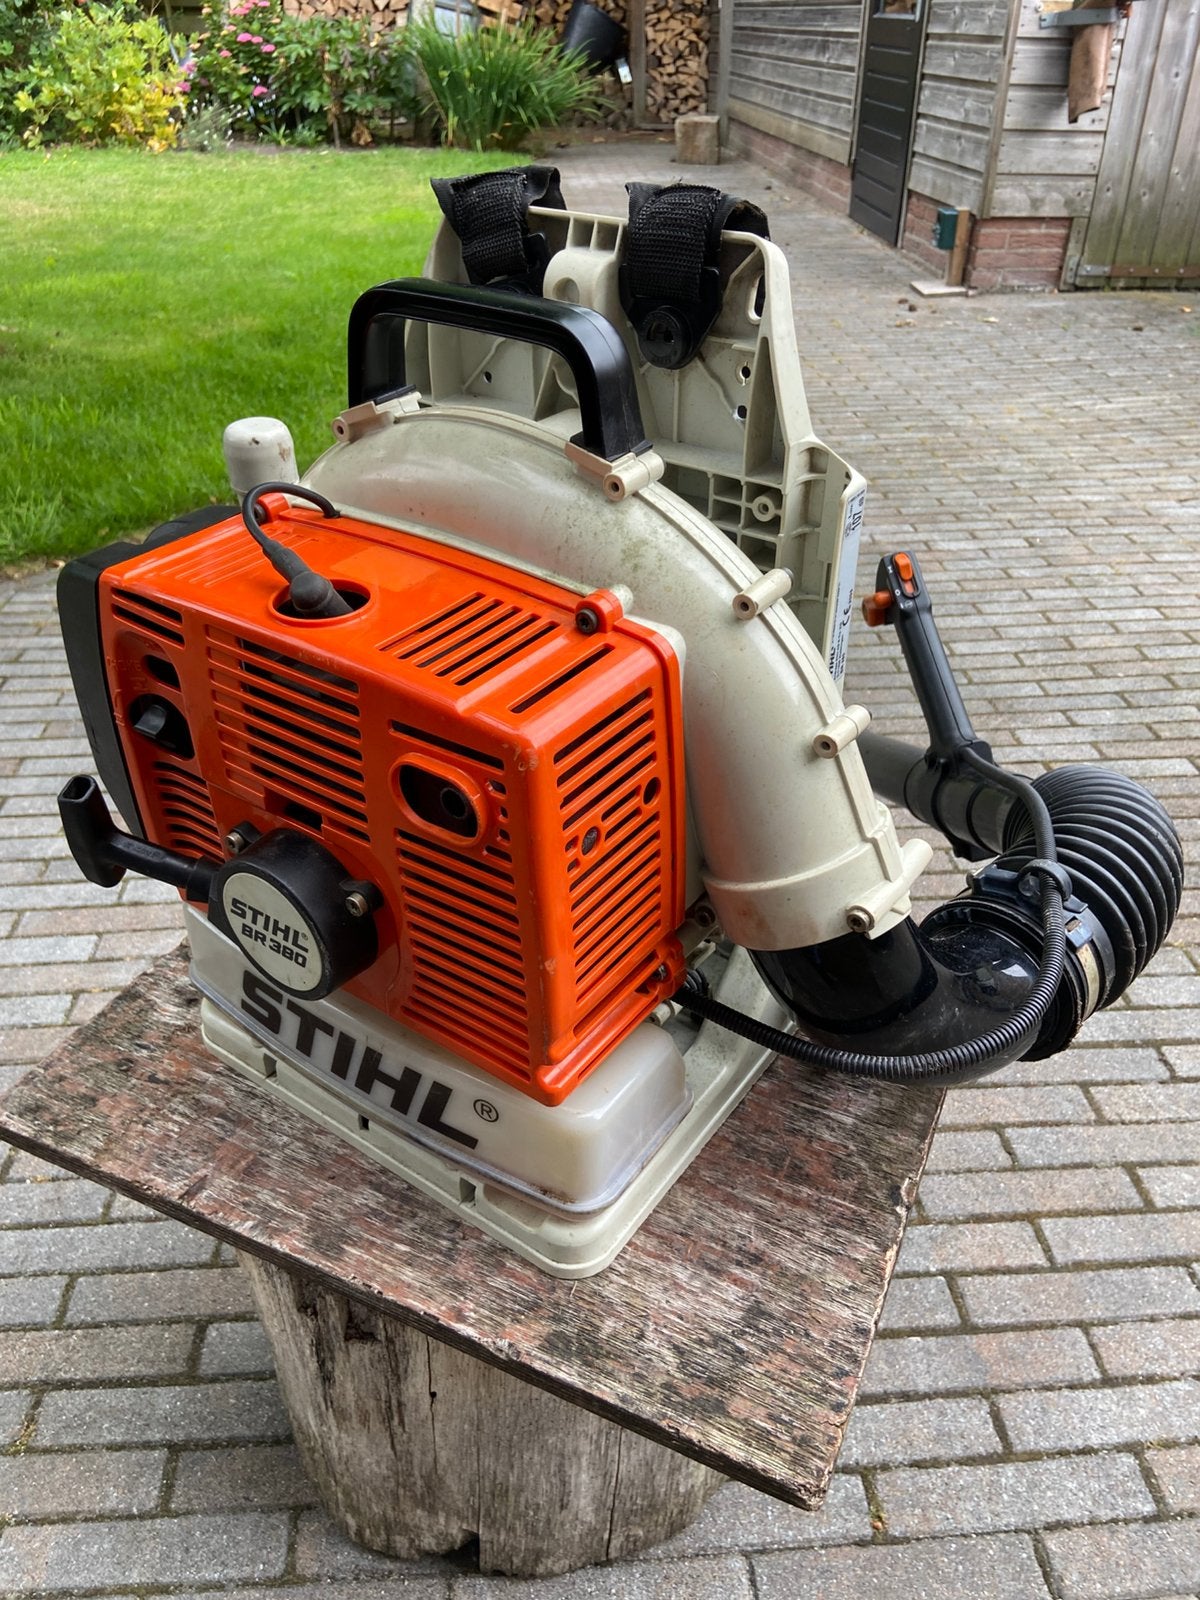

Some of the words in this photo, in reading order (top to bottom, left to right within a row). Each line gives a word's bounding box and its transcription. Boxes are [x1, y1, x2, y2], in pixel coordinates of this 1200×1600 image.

[851, 510, 862, 531] 107
[241, 923, 267, 947] BR
[268, 938, 308, 969] 380
